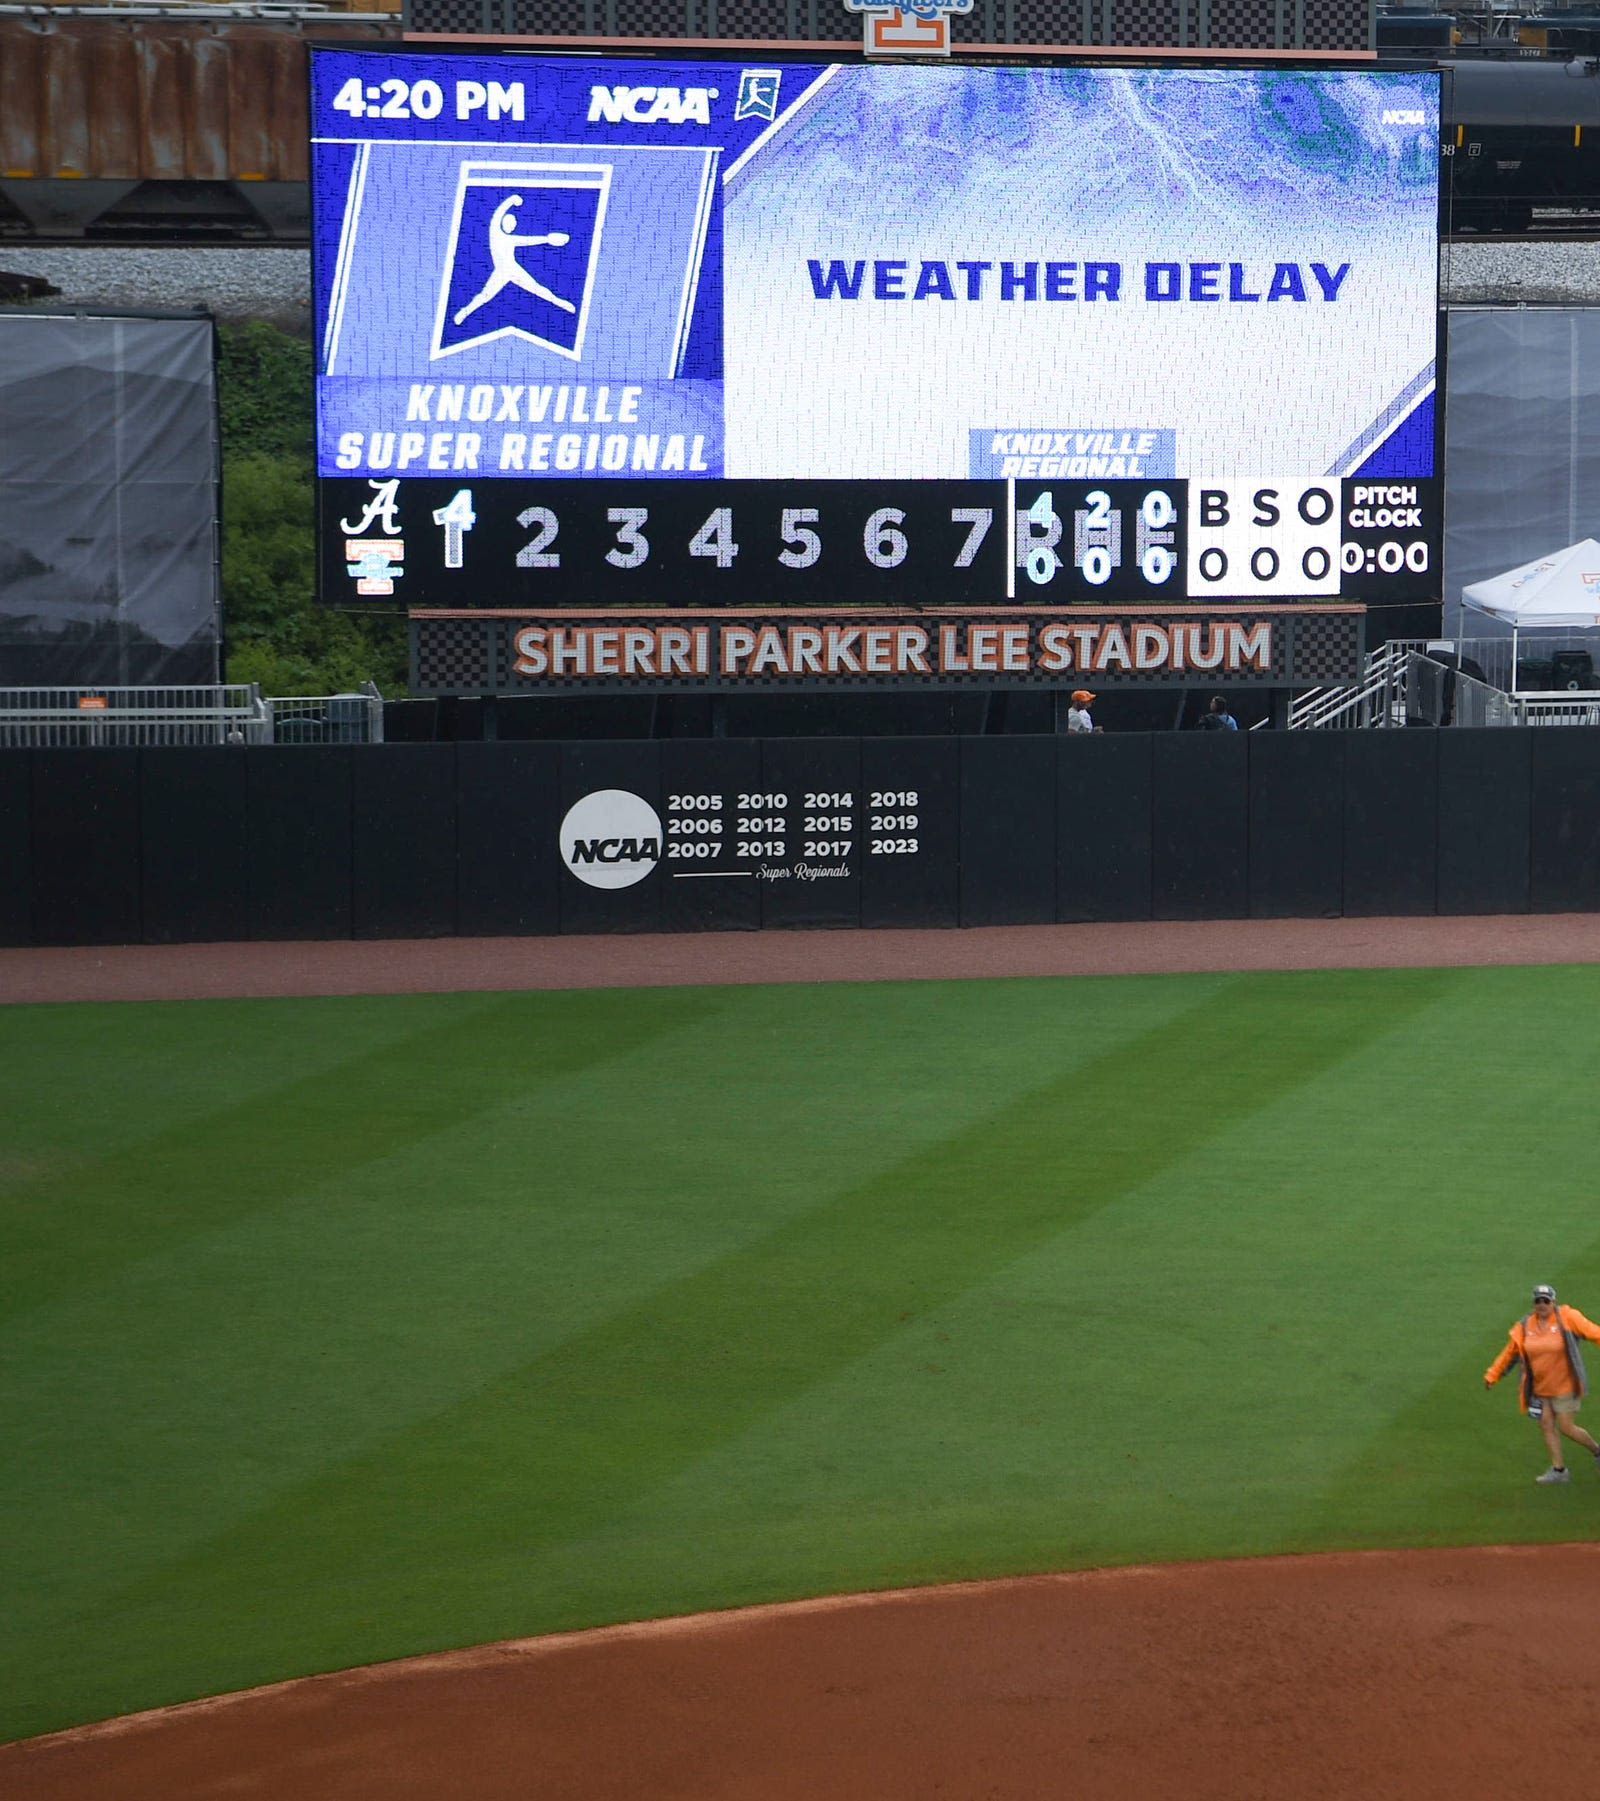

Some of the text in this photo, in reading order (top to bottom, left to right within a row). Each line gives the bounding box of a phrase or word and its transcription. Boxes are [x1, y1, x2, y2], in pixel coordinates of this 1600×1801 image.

[333, 78, 525, 121] 4:20 PM
[1382, 110, 1425, 125] NCAA
[807, 258, 1351, 303] WEATHER DELAY
[406, 384, 643, 424] KNOXVILLE
[335, 432, 709, 473] SUPER REGIONAL
[991, 433, 1157, 455] KNOXVILLE
[1000, 456, 1145, 478] REGIONAL
[340, 479, 402, 535] A
[1028, 491, 1057, 528] 4
[1084, 490, 1112, 530] 2
[1142, 490, 1173, 529] 0
[1200, 487, 1334, 527] B S O
[1353, 486, 1417, 505] PITCH
[1348, 507, 1423, 528] CLOCK
[515, 506, 561, 568] 2
[605, 507, 650, 569] 3
[688, 507, 739, 568] 4
[777, 508, 822, 569] 5
[863, 507, 909, 569] 6
[951, 508, 993, 568] 7
[1026, 546, 1056, 585] 0
[1082, 546, 1113, 585] 0
[1141, 546, 1173, 585] 0
[1199, 546, 1331, 582] 0 0 0
[1341, 541, 1428, 573] 0:00
[513, 622, 1272, 676] SHERRI PARKER LEE STADIUM
[668, 791, 919, 811] 2005 2010 2014 2018
[668, 815, 919, 835] 2006 2012 2015 2019
[571, 837, 661, 864] NCAA
[667, 839, 919, 858] 2007 2013 2017 2023
[756, 862, 851, 883] Super Regionals
